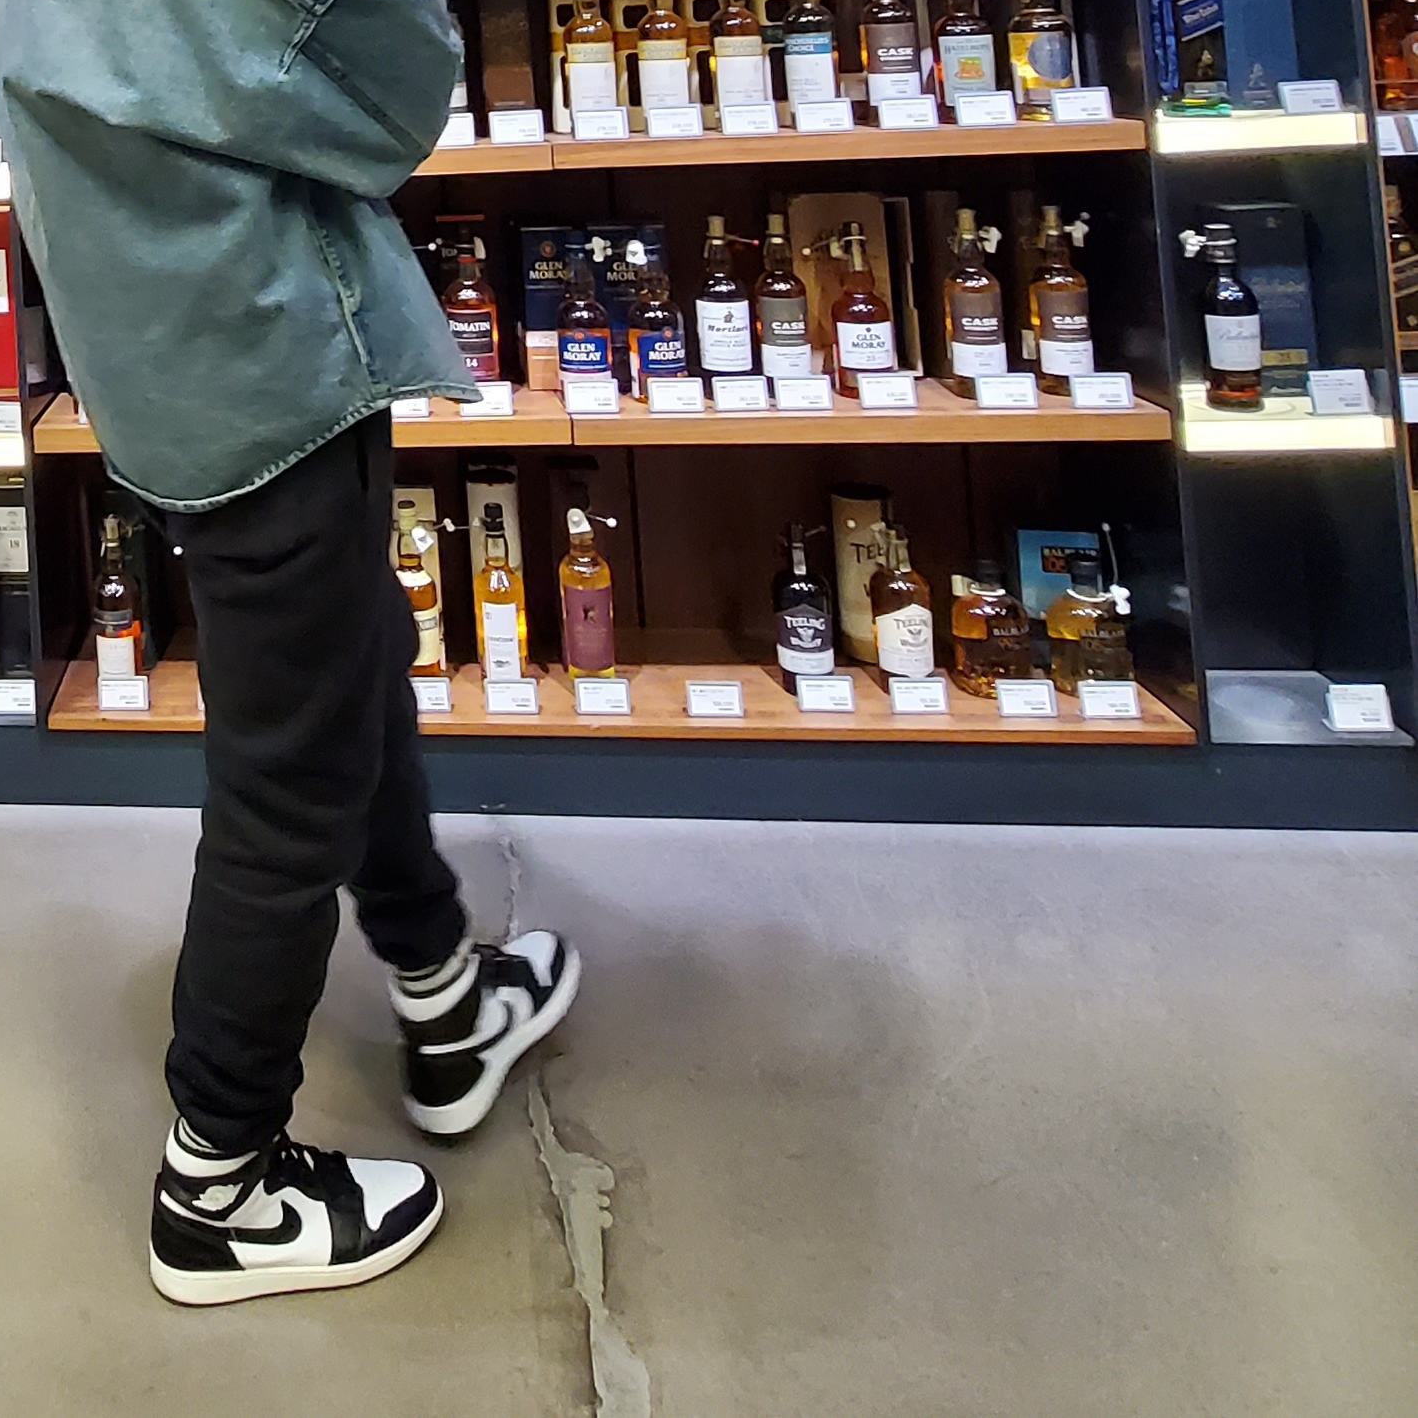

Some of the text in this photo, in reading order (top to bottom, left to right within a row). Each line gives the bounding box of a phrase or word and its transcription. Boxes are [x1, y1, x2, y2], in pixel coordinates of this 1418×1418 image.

[877, 47, 914, 57] CASK
[534, 261, 564, 271] GLEN
[612, 260, 638, 272] GLE
[607, 270, 636, 281] MOR
[449, 319, 491, 333] TOMATIN
[771, 321, 806, 330] CASK
[961, 317, 999, 326] CASK
[567, 342, 595, 352] GLEN
[654, 340, 682, 352] GLEN
[851, 341, 886, 349] MORAY
[563, 350, 602, 361] MORAY
[465, 358, 479, 368] 14
